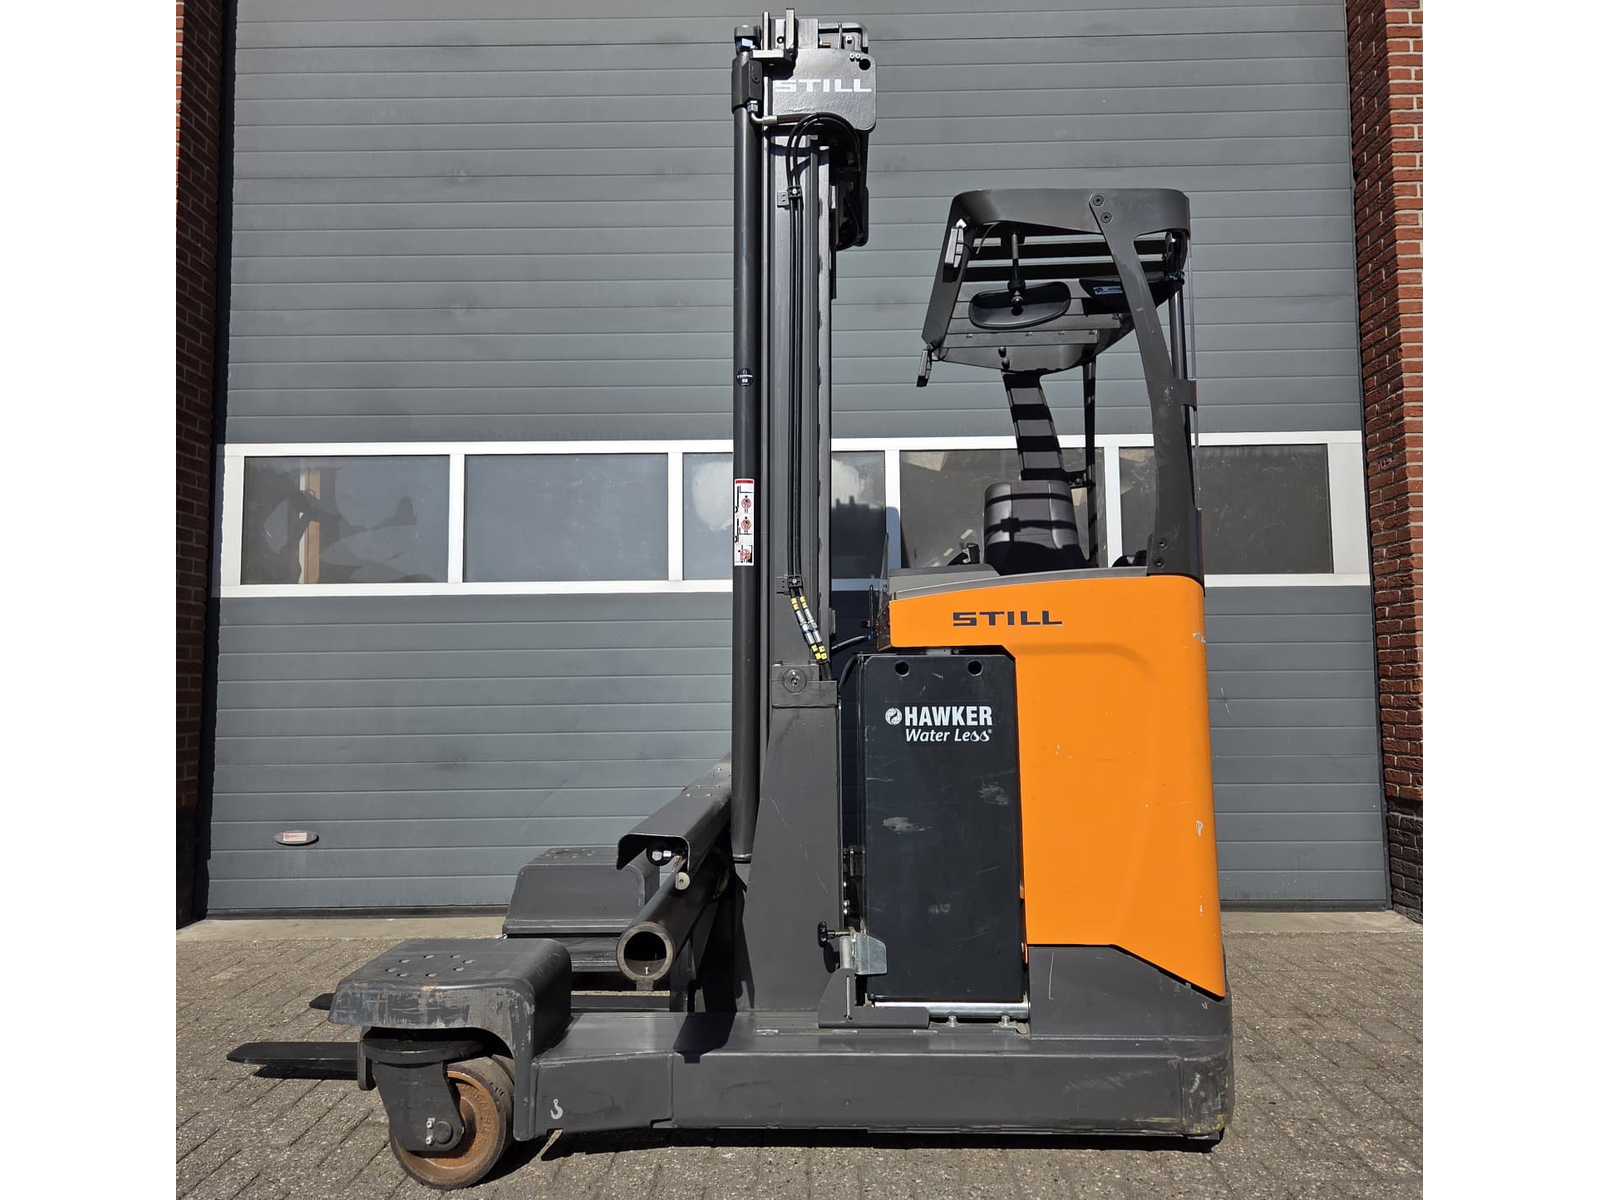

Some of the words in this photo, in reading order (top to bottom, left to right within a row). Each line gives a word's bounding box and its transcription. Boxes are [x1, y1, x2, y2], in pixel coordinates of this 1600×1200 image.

[773, 79, 872, 93] STILL
[953, 611, 1062, 626] STILL
[904, 706, 993, 726] HAWKER
[905, 728, 950, 742] Water
